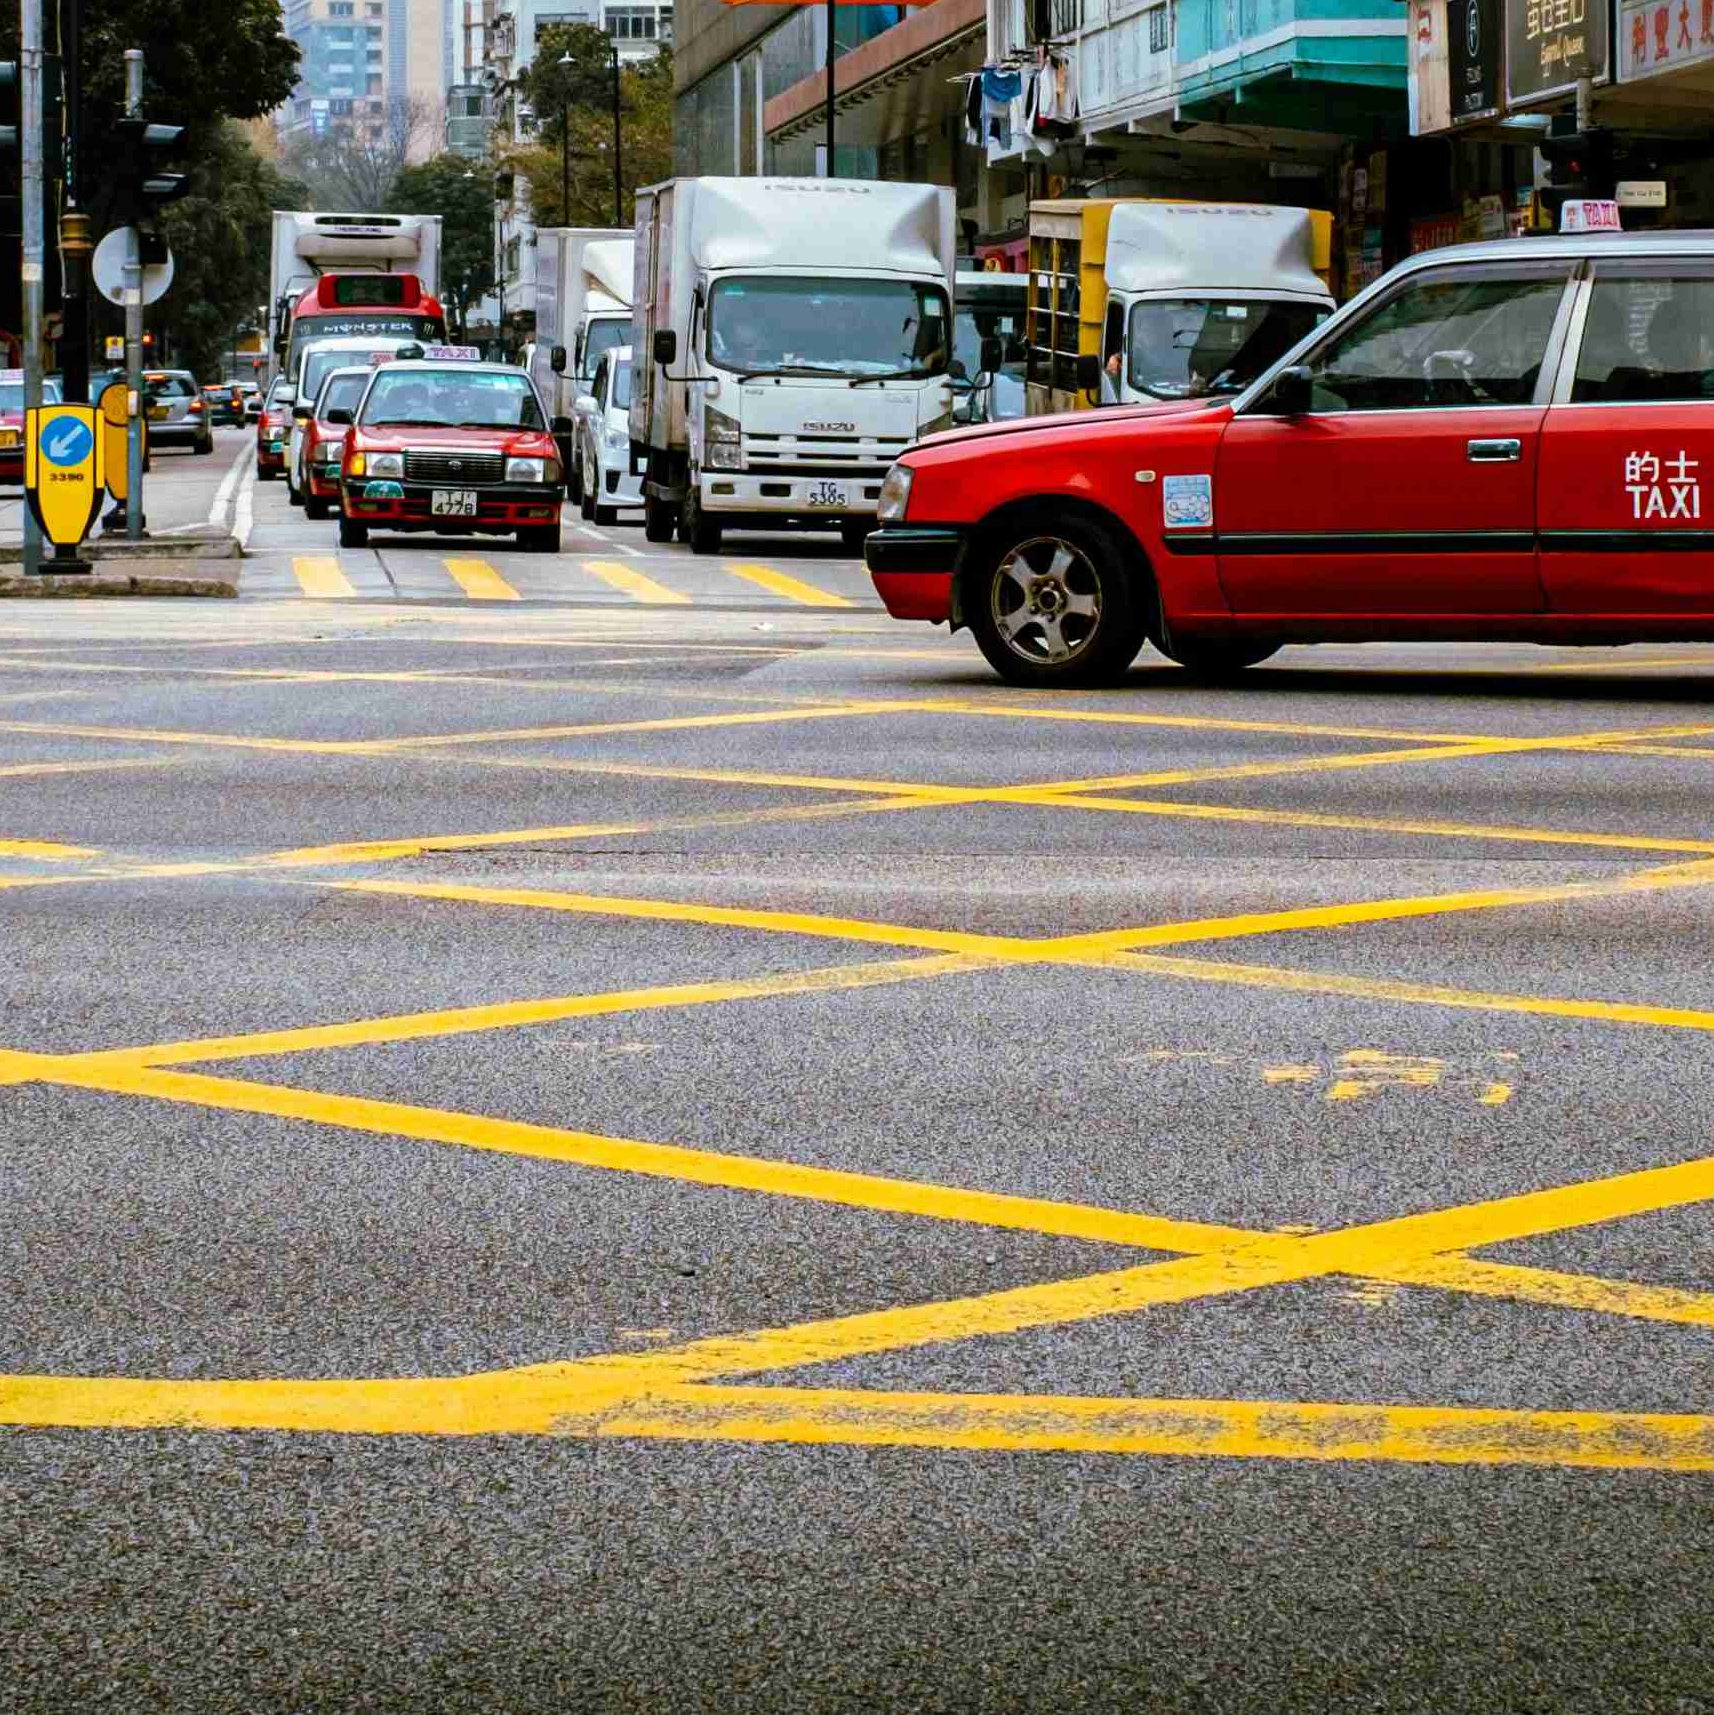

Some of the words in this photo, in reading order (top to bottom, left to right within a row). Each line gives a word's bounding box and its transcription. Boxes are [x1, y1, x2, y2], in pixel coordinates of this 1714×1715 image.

[764, 184, 872, 194] ISUZU
[1581, 202, 1619, 226] TAXI
[429, 347, 477, 360] TAXI
[803, 422, 856, 432] ISUZU
[1624, 450, 1700, 484] 的士
[817, 482, 838, 494] TG
[1624, 484, 1702, 519] TAXI
[434, 503, 474, 515] 4778
